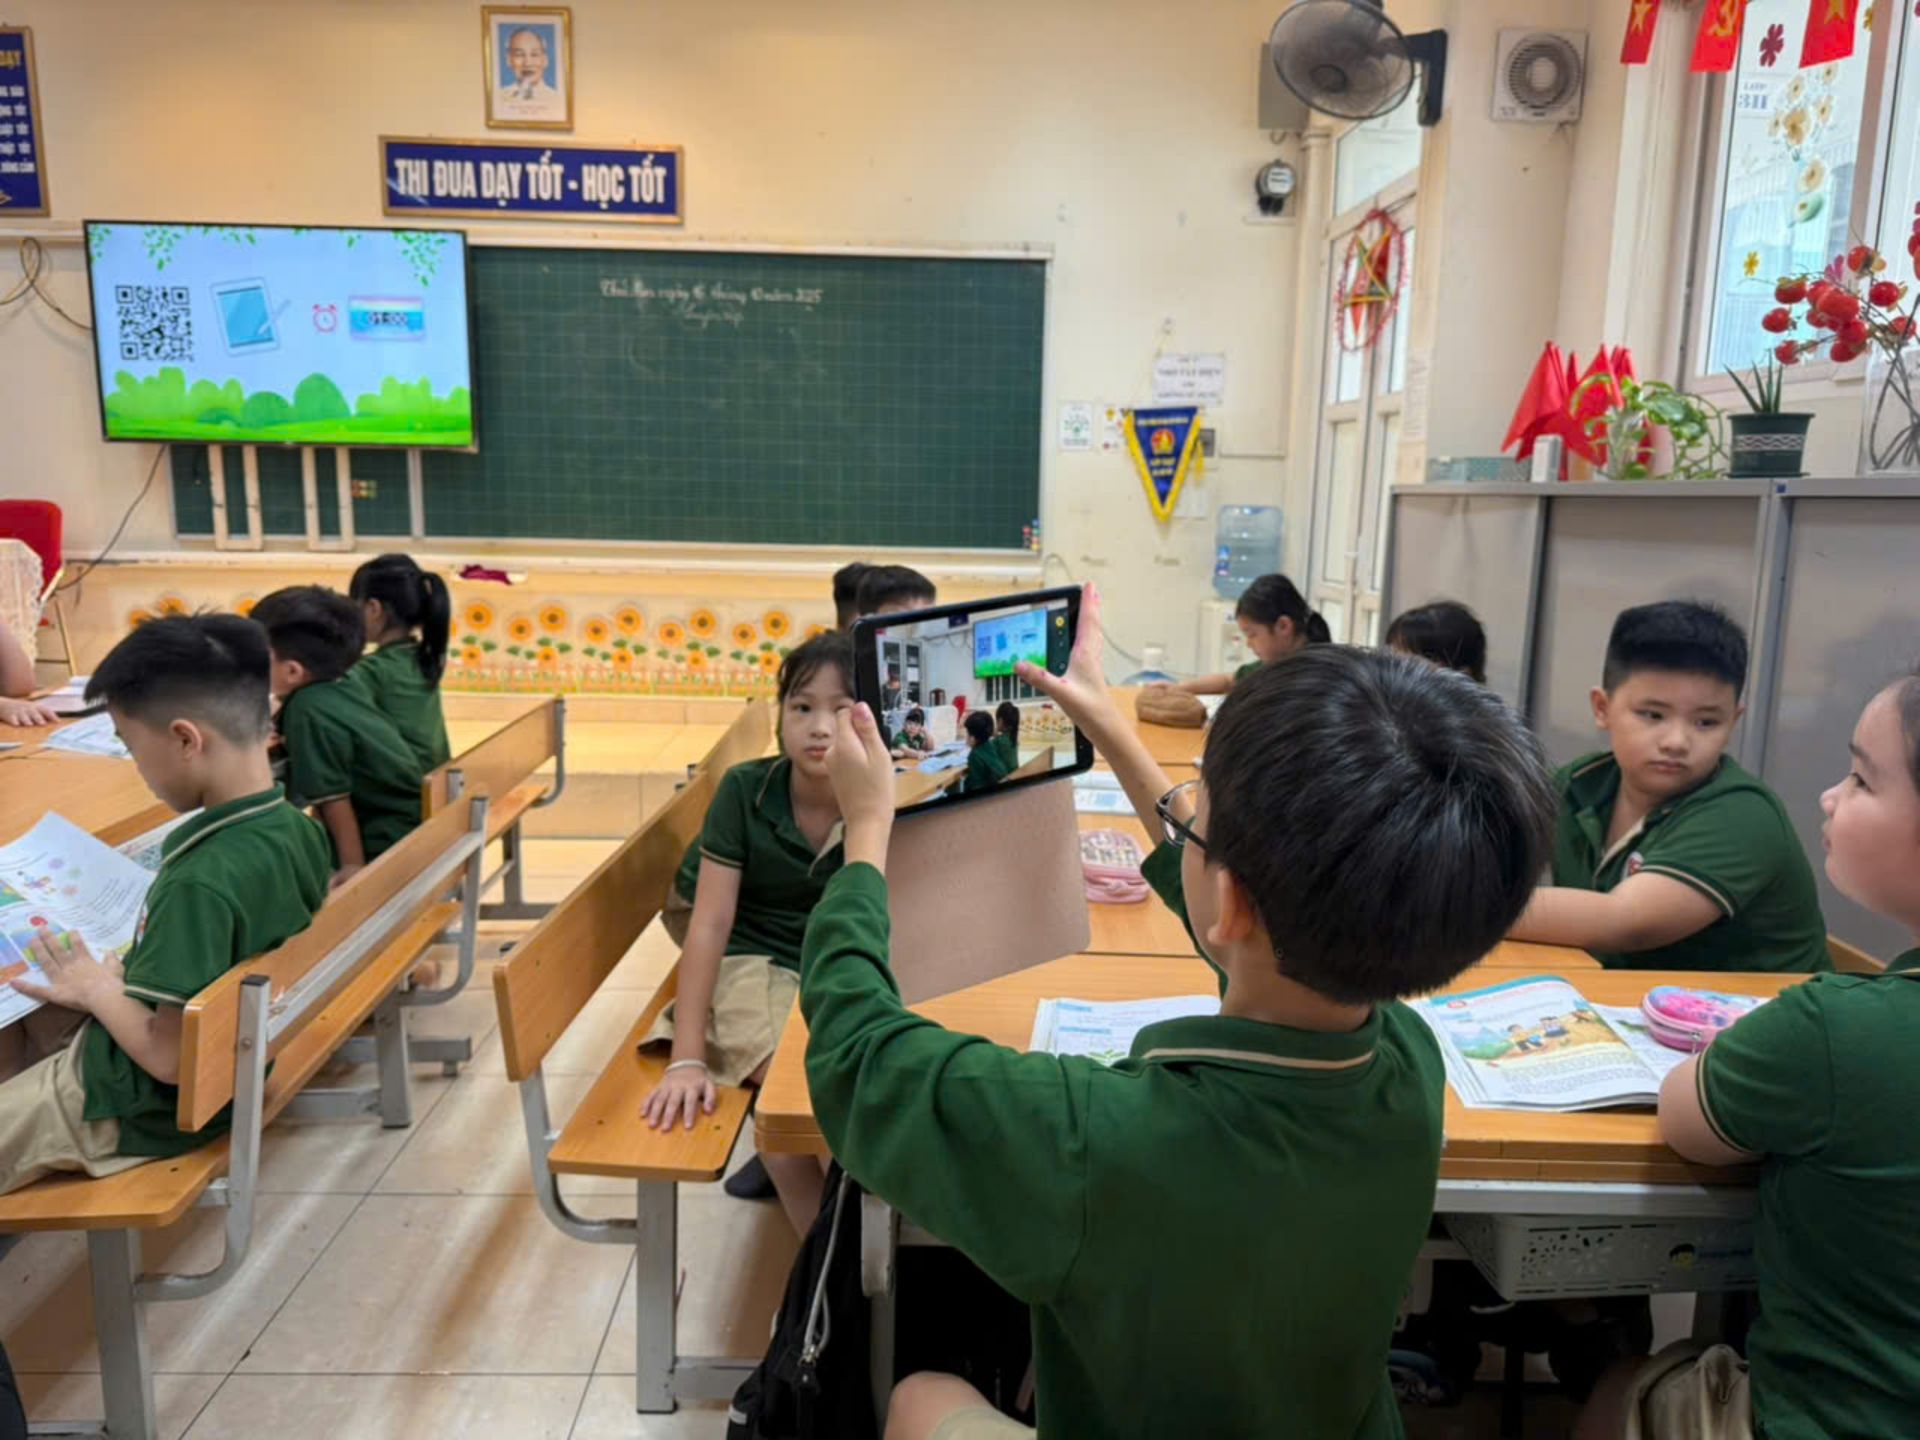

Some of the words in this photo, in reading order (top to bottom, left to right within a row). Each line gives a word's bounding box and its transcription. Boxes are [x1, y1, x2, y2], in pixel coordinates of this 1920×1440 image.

[394, 158, 429, 197] THI
[432, 160, 477, 199] ĐUA
[480, 161, 522, 207] DẠY
[526, 150, 564, 201] TỐT
[581, 164, 625, 209] HỌC
[628, 153, 667, 204] TỐT
